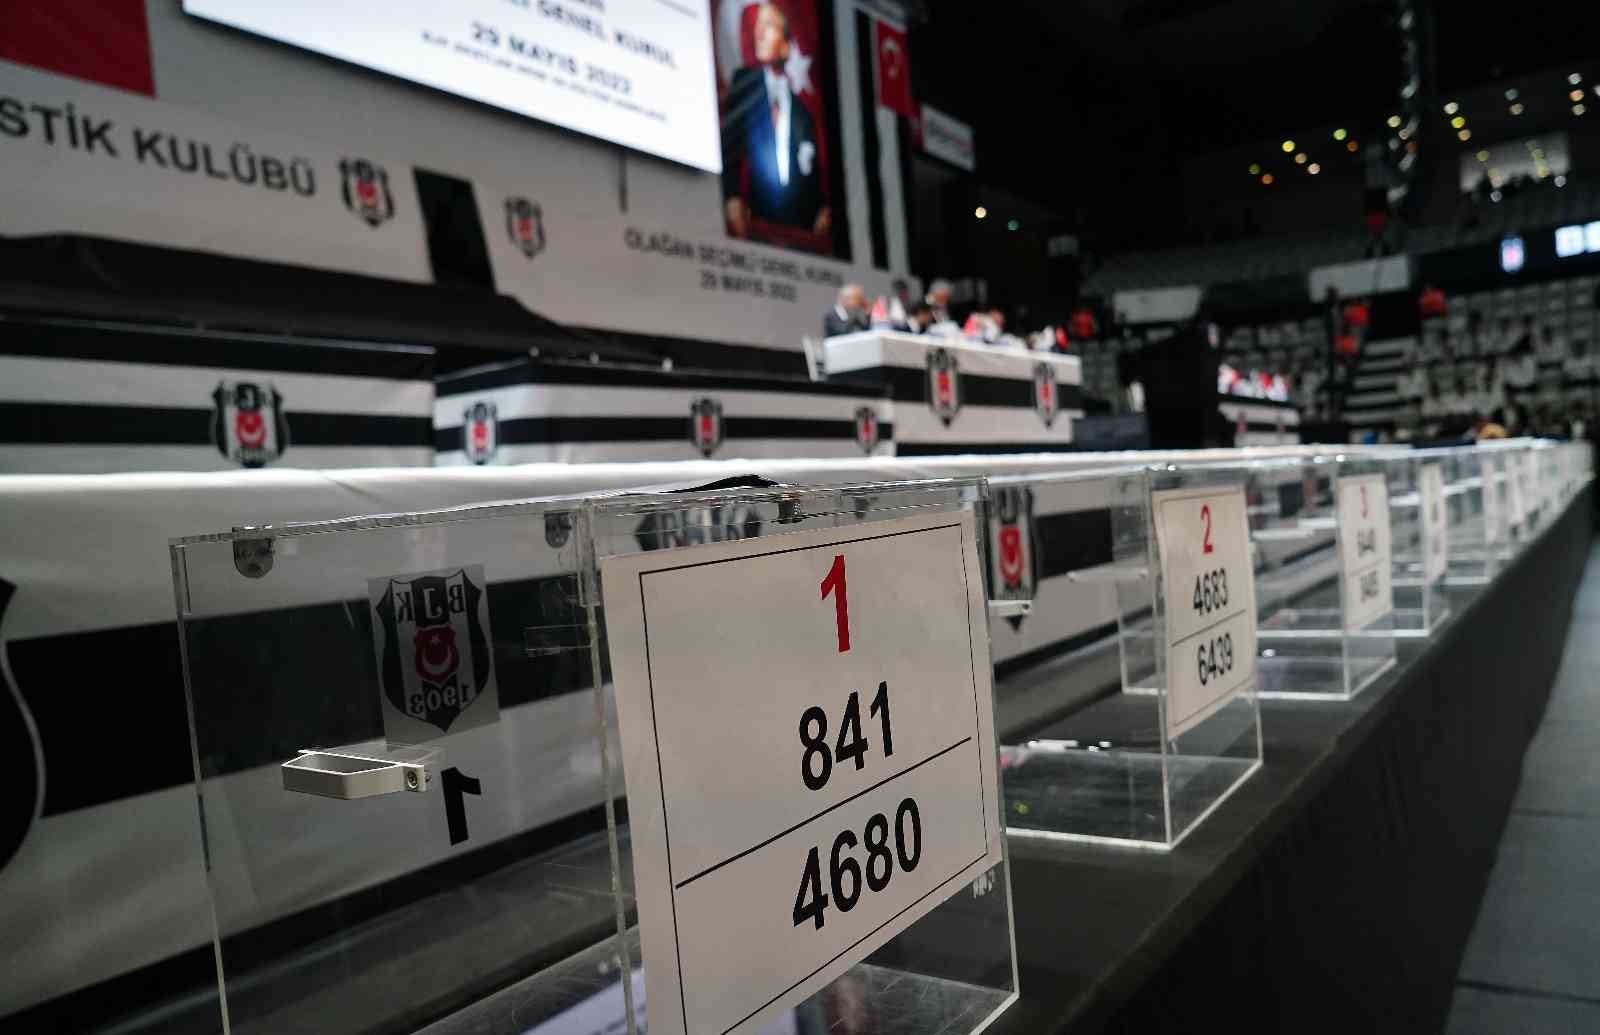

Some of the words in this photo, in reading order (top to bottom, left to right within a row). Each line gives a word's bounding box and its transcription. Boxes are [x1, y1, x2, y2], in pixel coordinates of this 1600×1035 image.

[471, 20, 499, 46] 29
[508, 35, 577, 75] MAYIS
[585, 63, 632, 95] 2022
[0, 98, 119, 158] STİK
[132, 127, 315, 197] KULÜBÜ
[1201, 504, 1214, 555] 2
[820, 554, 850, 653] 1
[1193, 568, 1229, 616] 4683
[1197, 632, 1233, 686] 6439
[799, 680, 893, 791] 841
[793, 797, 922, 930] 4680
